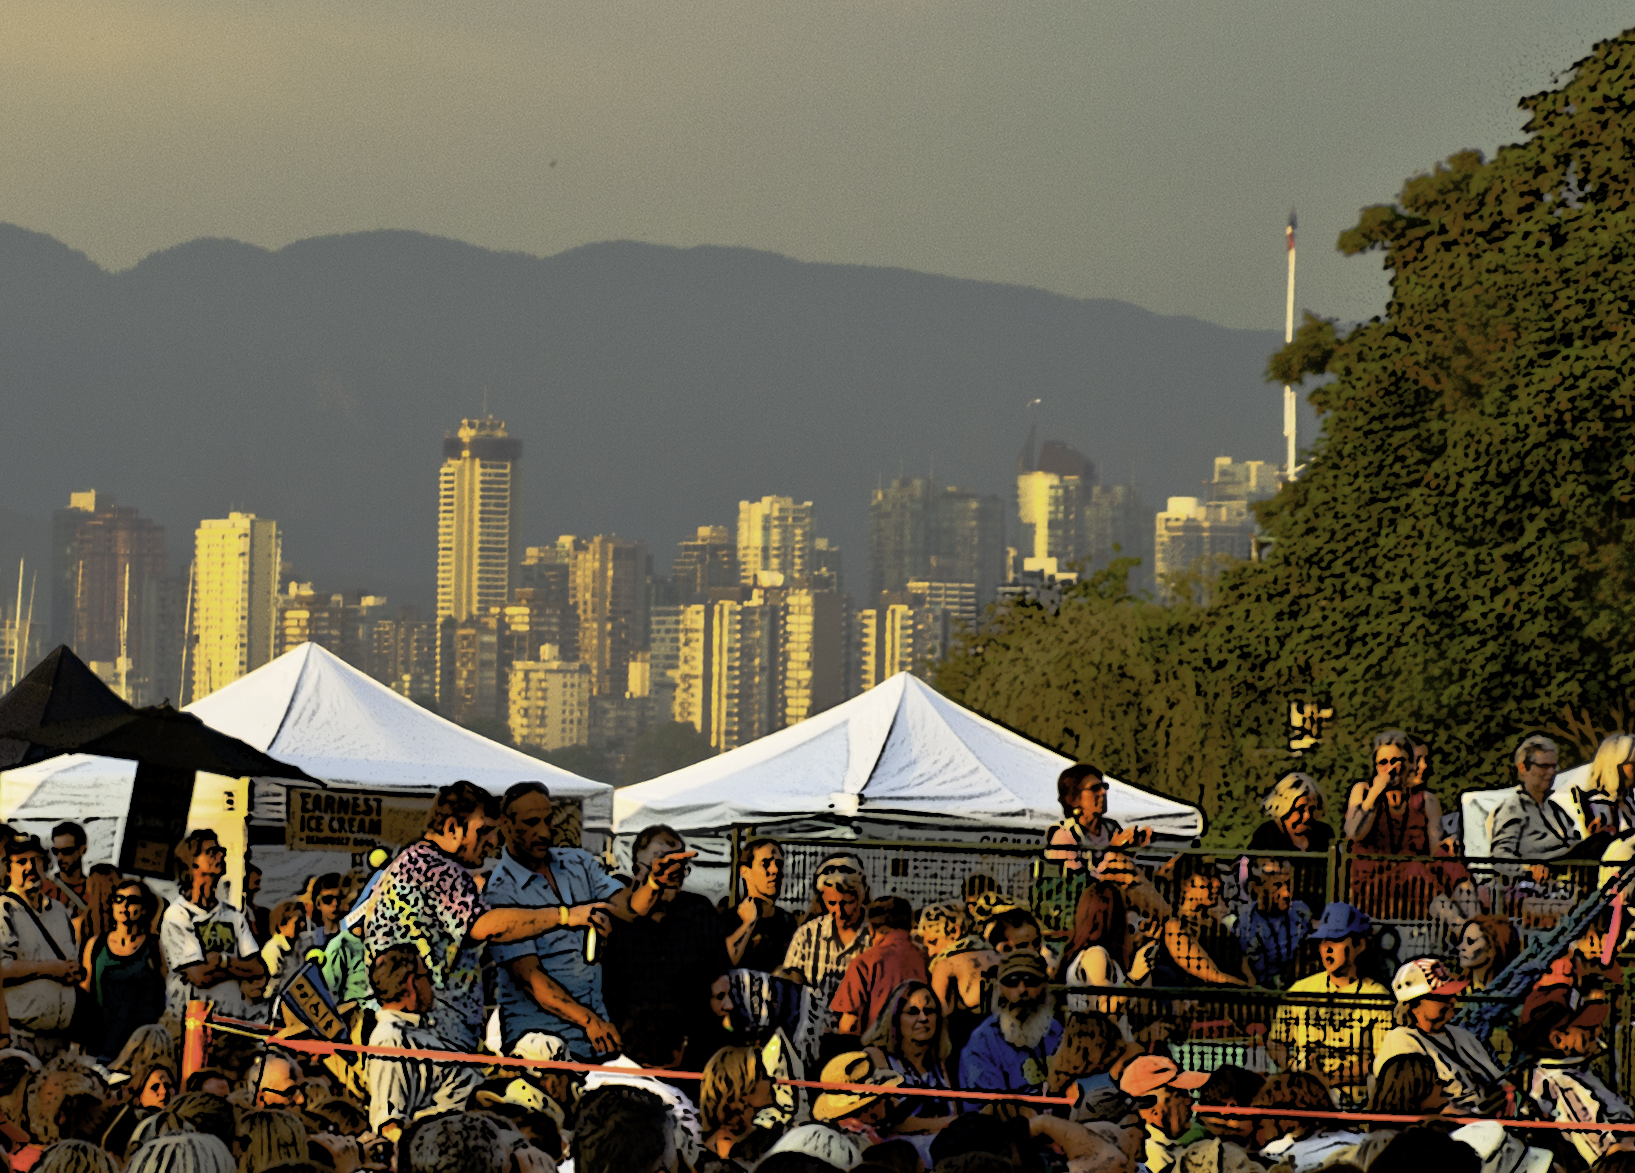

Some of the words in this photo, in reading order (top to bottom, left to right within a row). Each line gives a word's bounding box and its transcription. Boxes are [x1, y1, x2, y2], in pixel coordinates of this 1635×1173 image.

[300, 792, 382, 817] EARNEST
[300, 815, 324, 833] ICE
[328, 816, 382, 835] CREAM
